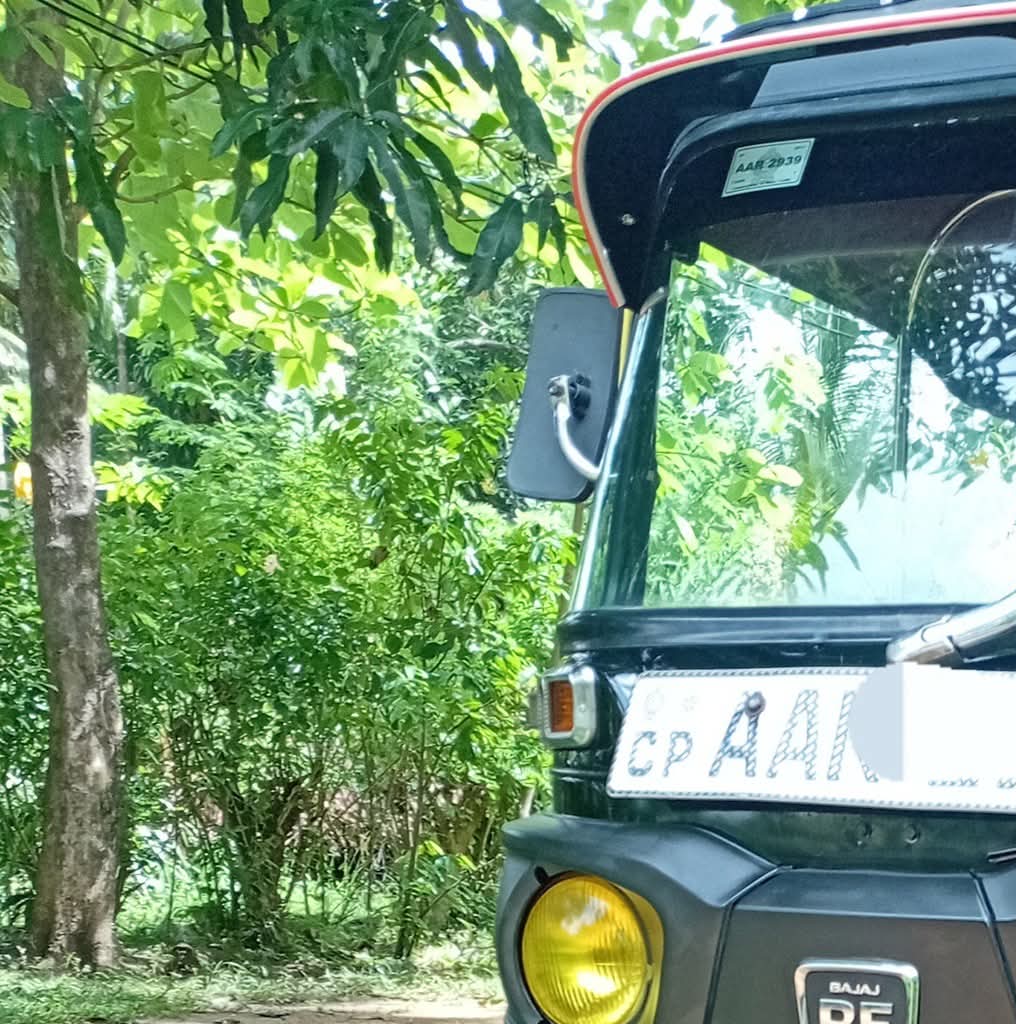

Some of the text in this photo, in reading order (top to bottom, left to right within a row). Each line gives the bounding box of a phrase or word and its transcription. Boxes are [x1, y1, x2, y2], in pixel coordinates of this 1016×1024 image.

[735, 155, 802, 173] AAR 2939
[628, 731, 693, 777] CP
[828, 981, 881, 996] BAJAJ
